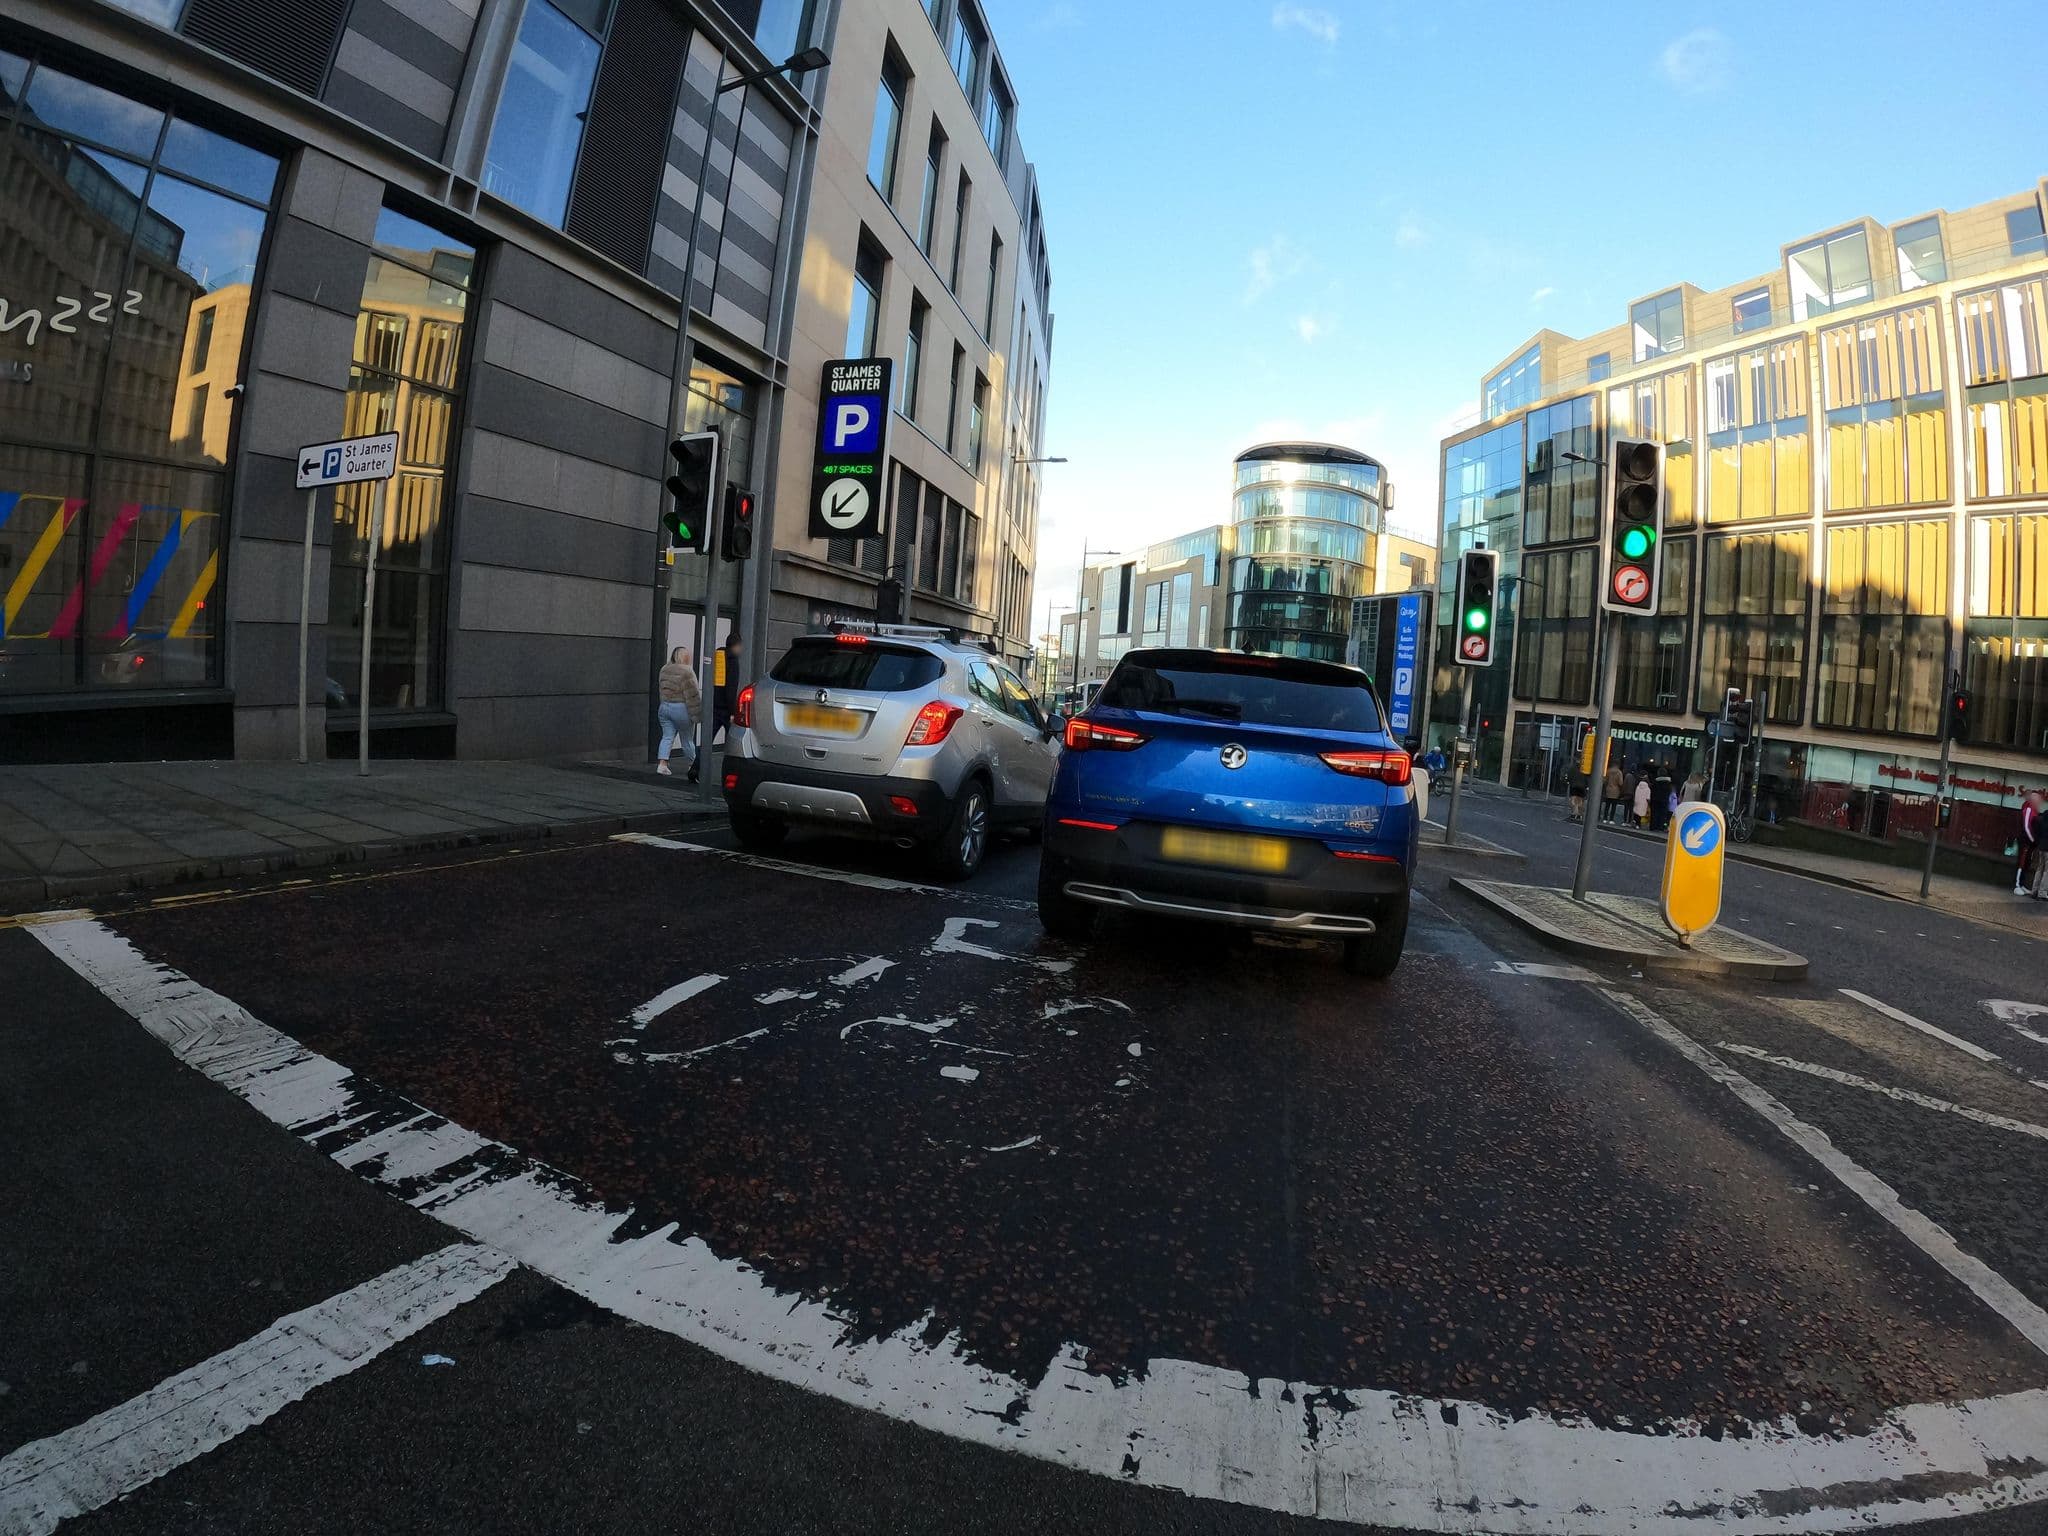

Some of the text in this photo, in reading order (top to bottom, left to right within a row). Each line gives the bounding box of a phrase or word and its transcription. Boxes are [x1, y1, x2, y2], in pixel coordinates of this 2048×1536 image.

[846, 366, 881, 378] JAMES
[831, 379, 880, 392] QUARTER
[834, 405, 869, 446] P
[345, 443, 392, 457] St James
[327, 452, 339, 476] P
[346, 460, 386, 473] Quarter
[839, 466, 873, 474] SPACES
[1655, 733, 1699, 748] COFFEE
